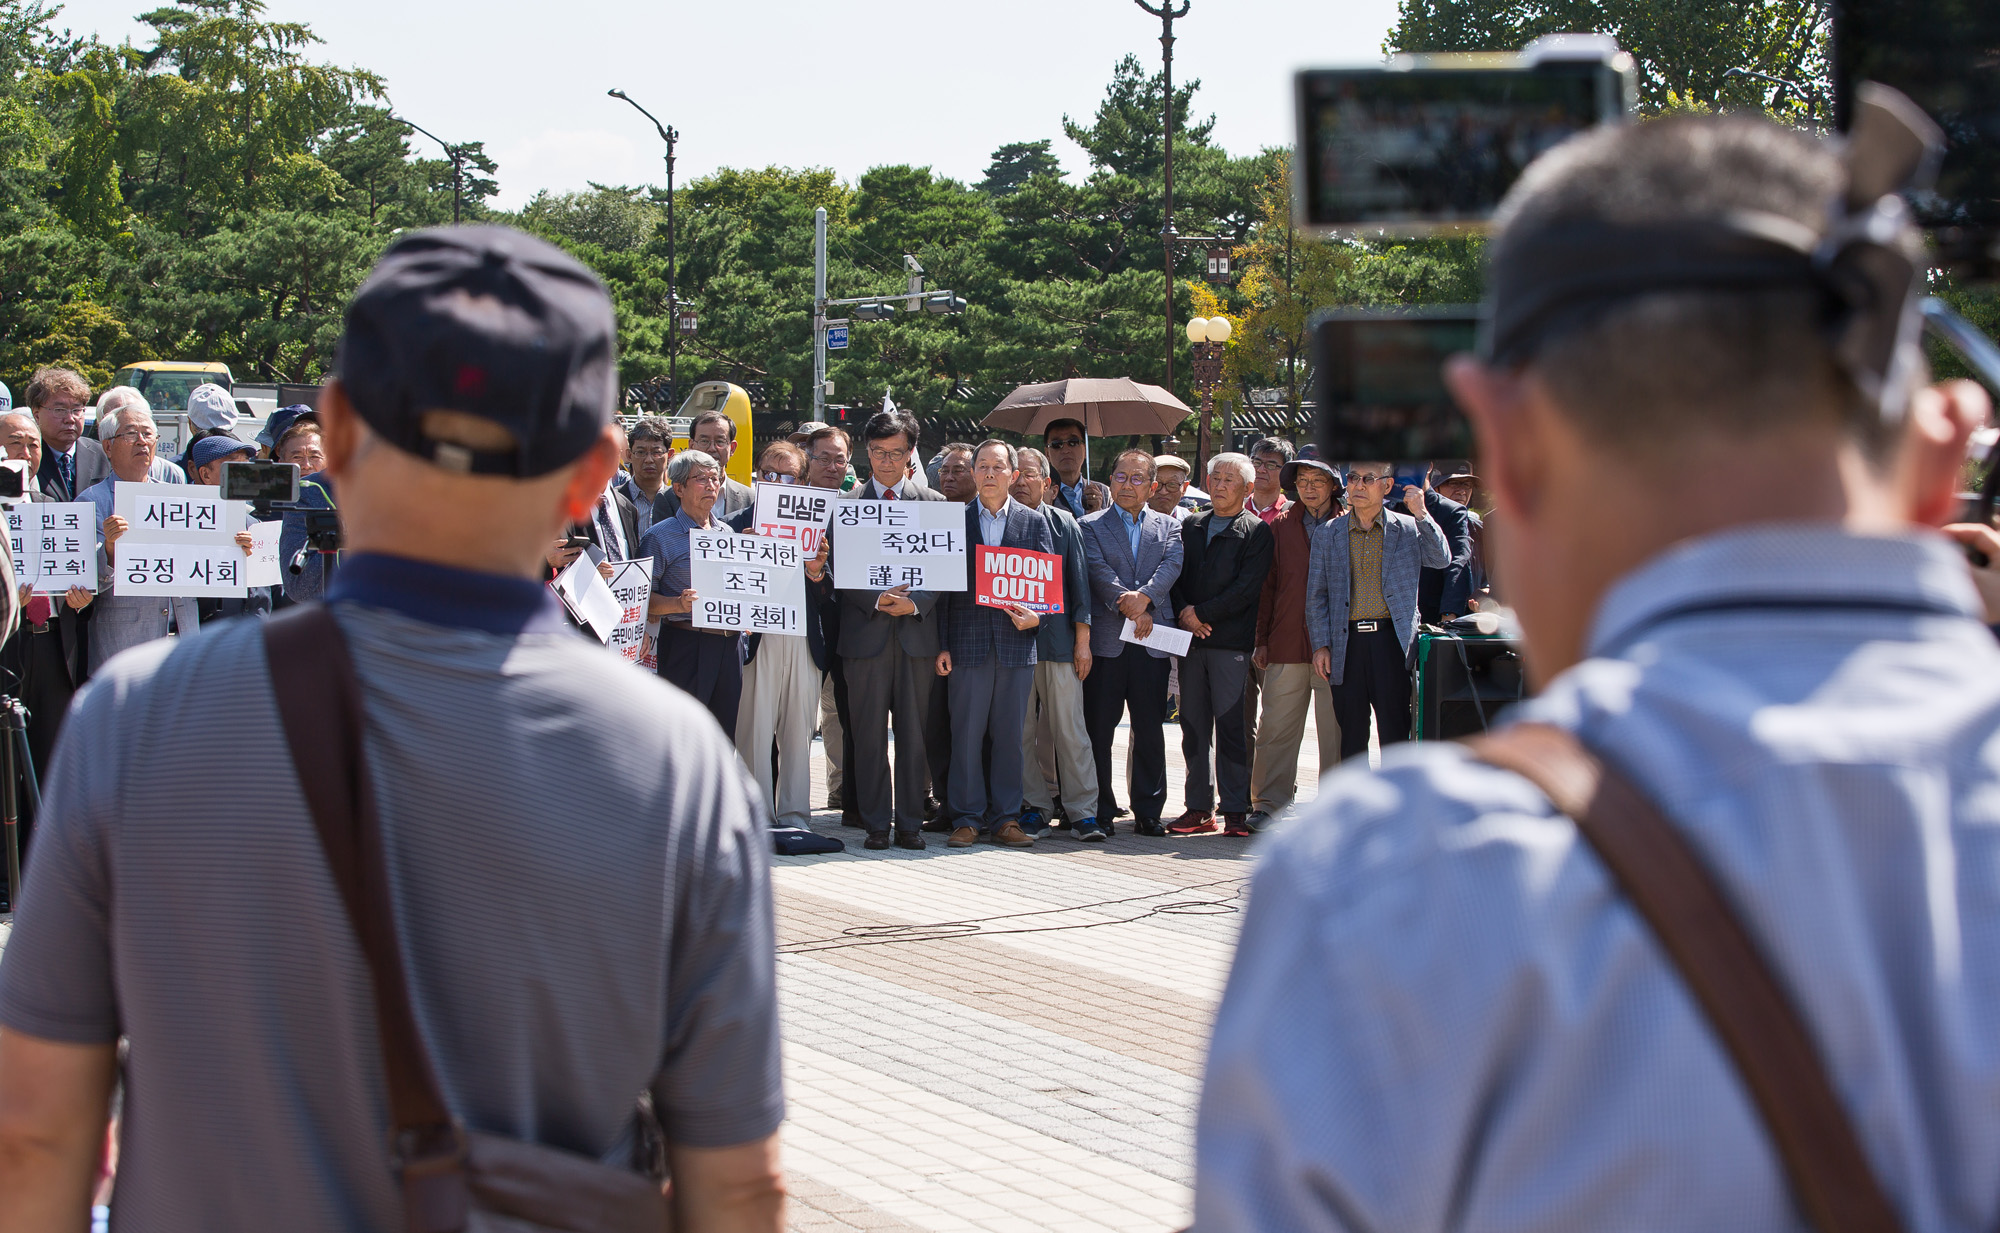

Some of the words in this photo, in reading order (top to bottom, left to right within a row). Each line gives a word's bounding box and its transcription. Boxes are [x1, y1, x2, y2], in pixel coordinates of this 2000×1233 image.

[144, 502, 216, 530] 사라진
[777, 494, 826, 522] 민심은
[838, 504, 908, 526] 정의는
[695, 535, 798, 568] 후안무치한
[881, 531, 964, 553] 죽었다.
[126, 558, 174, 584] 공정
[189, 558, 237, 586] 사회
[984, 552, 1053, 581] MOON
[637, 584, 649, 601] 만든
[725, 571, 768, 594] 조국
[992, 576, 1045, 603] OUT!
[704, 600, 741, 626] 임명
[612, 627, 634, 645] 국민이
[634, 623, 644, 641] 만든
